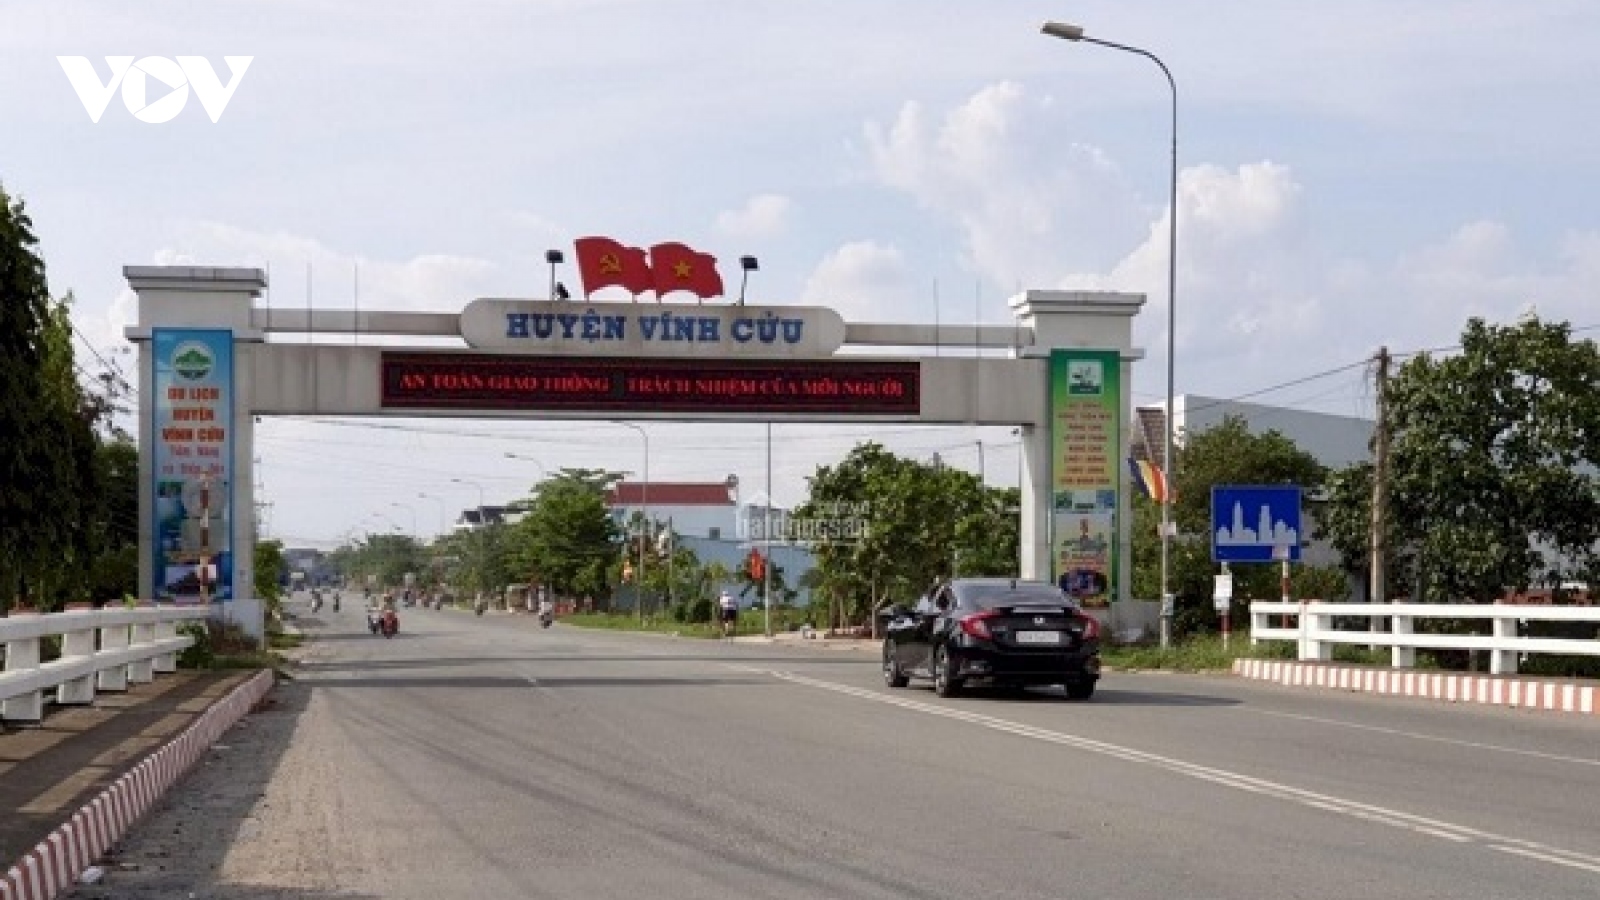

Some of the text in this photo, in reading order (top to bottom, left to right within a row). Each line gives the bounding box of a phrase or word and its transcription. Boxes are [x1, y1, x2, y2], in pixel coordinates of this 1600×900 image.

[506, 308, 626, 342] HUYỆN
[400, 374, 425, 389] AN
[487, 375, 538, 391] GIAO
